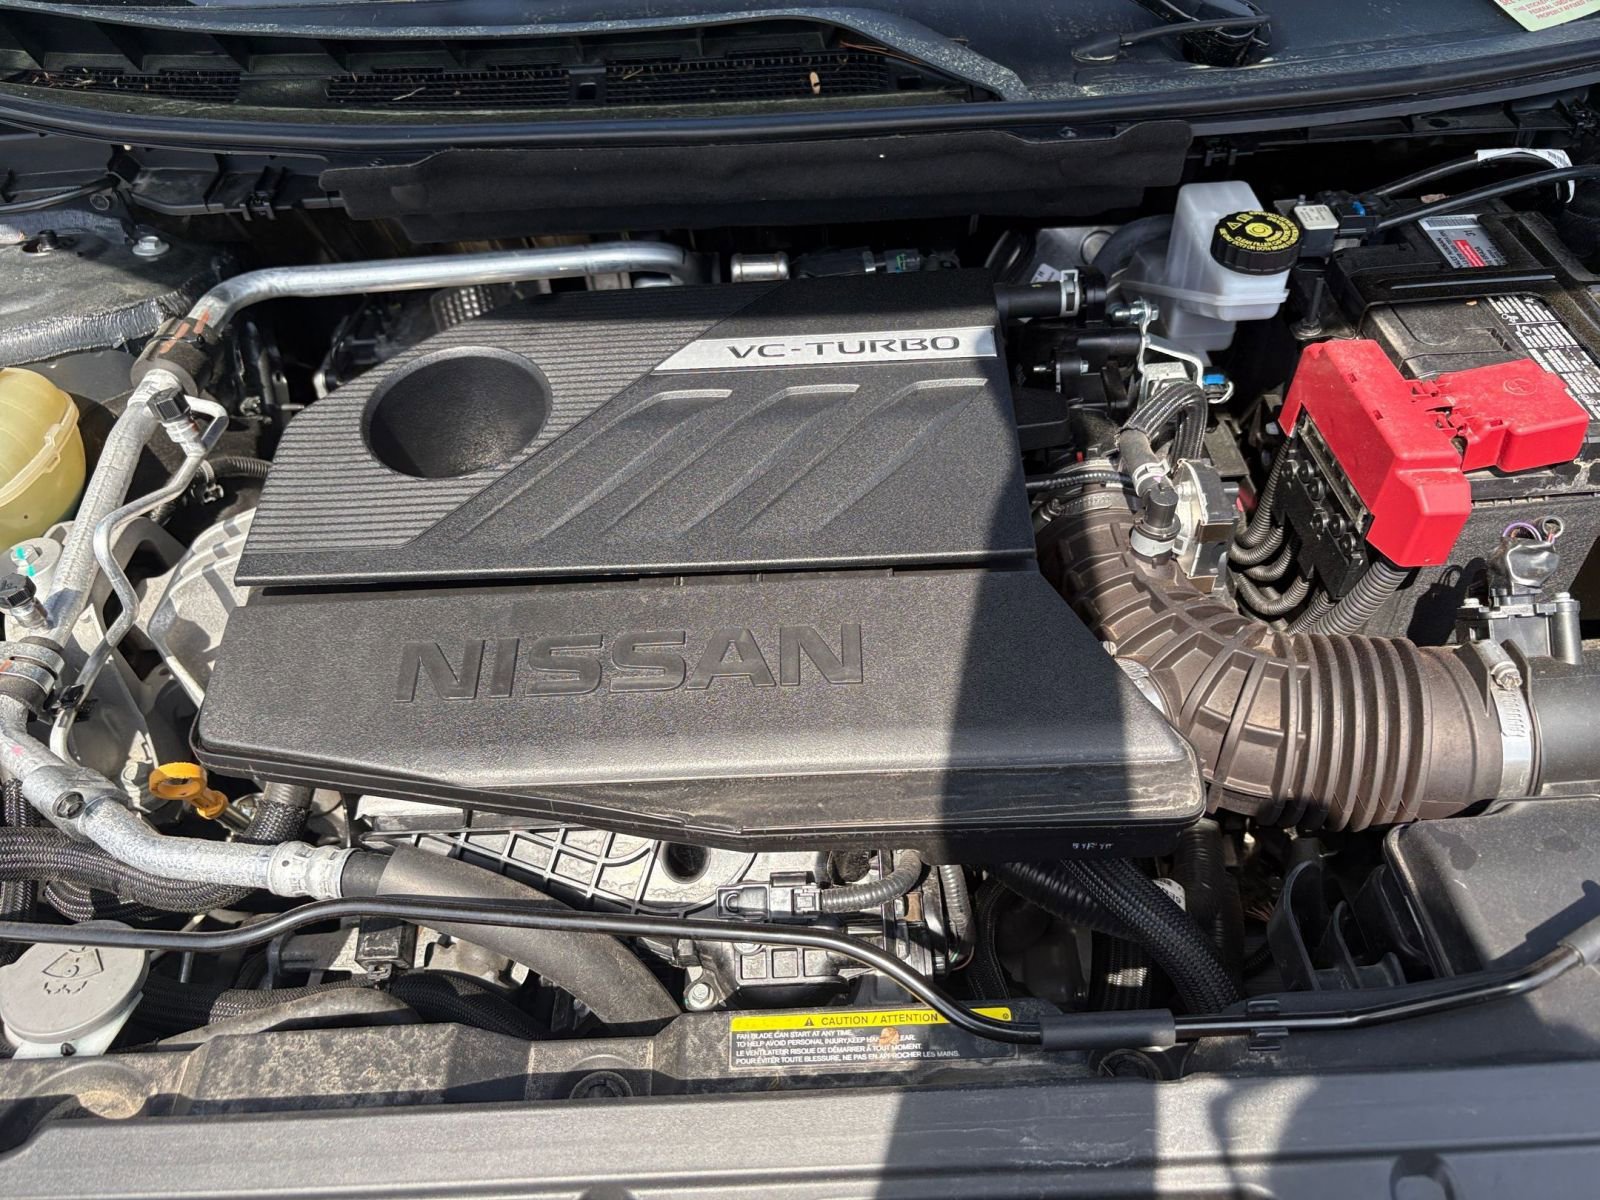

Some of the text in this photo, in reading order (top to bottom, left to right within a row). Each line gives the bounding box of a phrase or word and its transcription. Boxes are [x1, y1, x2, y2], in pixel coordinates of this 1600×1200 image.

[727, 335, 960, 359] VC-TURBO
[396, 623, 864, 702] NISSAN
[821, 1016, 868, 1026] CAUTION
[880, 1013, 938, 1024] ATTENTION
[751, 1031, 773, 1039] BLADE
[821, 1029, 835, 1037] ANY
[787, 1038, 824, 1046] PERSONAL
[746, 1048, 789, 1056] VENTILATEUR
[828, 1044, 865, 1053] DÉMARRER
[756, 1056, 780, 1064] ÉVITER
